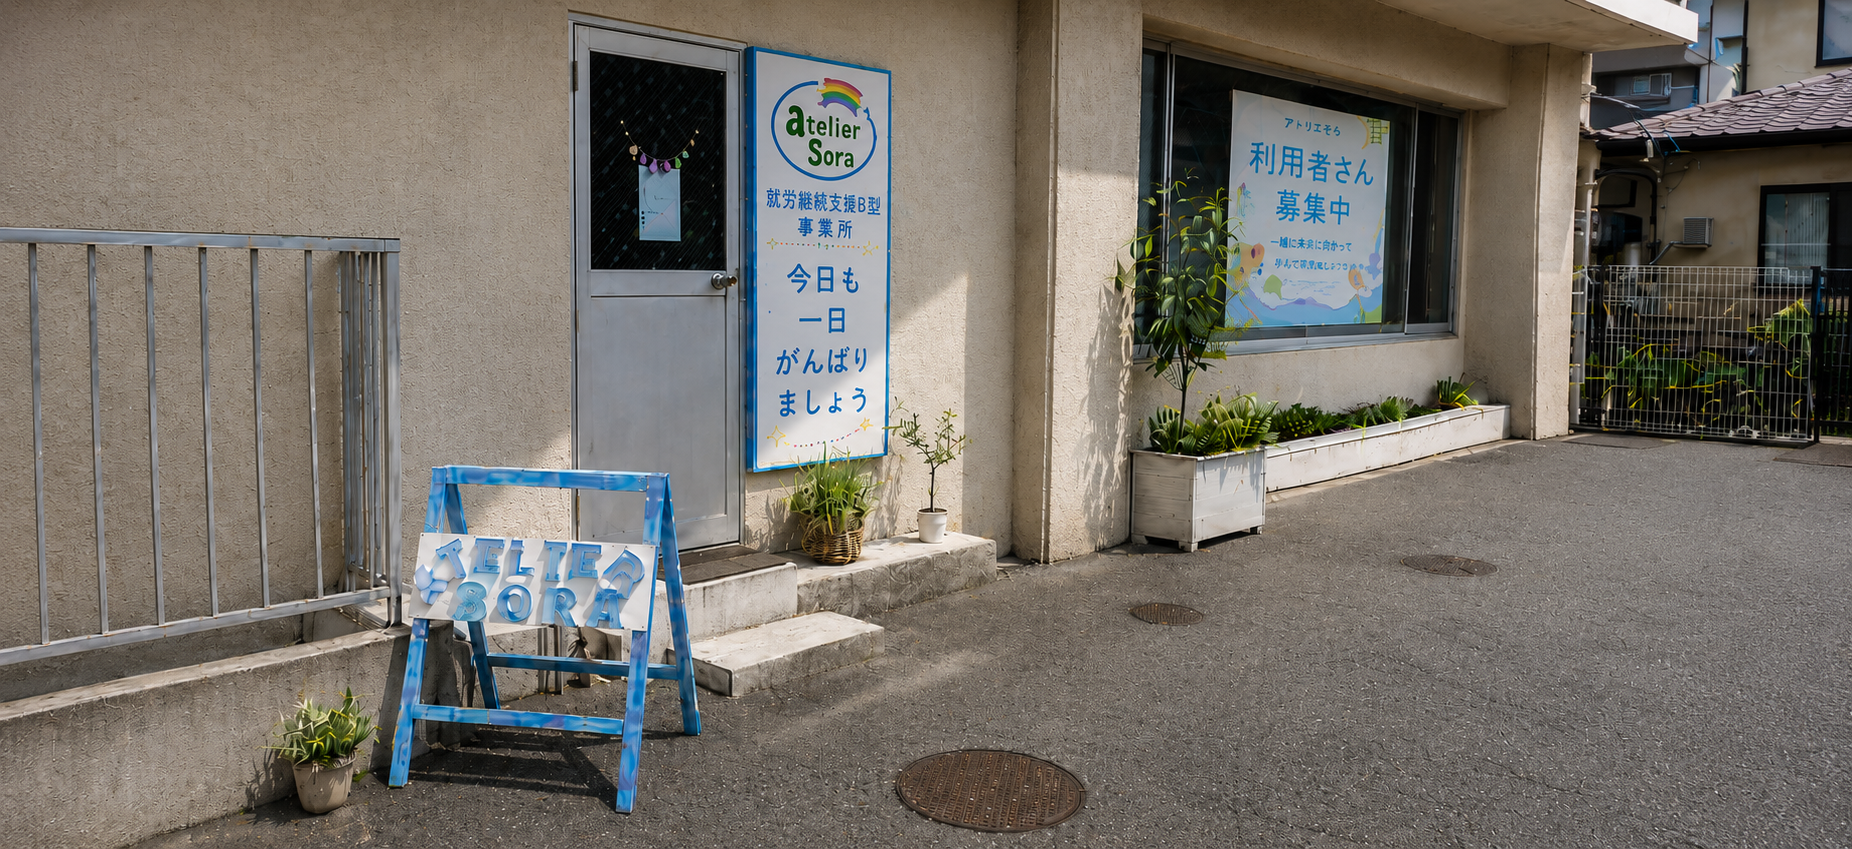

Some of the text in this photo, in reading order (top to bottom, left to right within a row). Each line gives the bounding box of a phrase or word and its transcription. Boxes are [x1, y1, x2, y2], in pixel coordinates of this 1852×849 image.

[786, 105, 860, 139] atelier
[1285, 117, 1341, 136] アトリエそら
[808, 138, 854, 167] Sora
[1249, 141, 1374, 186] 利用者さん
[1276, 189, 1350, 225] 募集中
[797, 217, 853, 239] 事業所
[787, 263, 859, 293] 今日も
[799, 307, 845, 333] 一日
[776, 346, 867, 375] がんばり
[779, 387, 867, 417] ましょう
